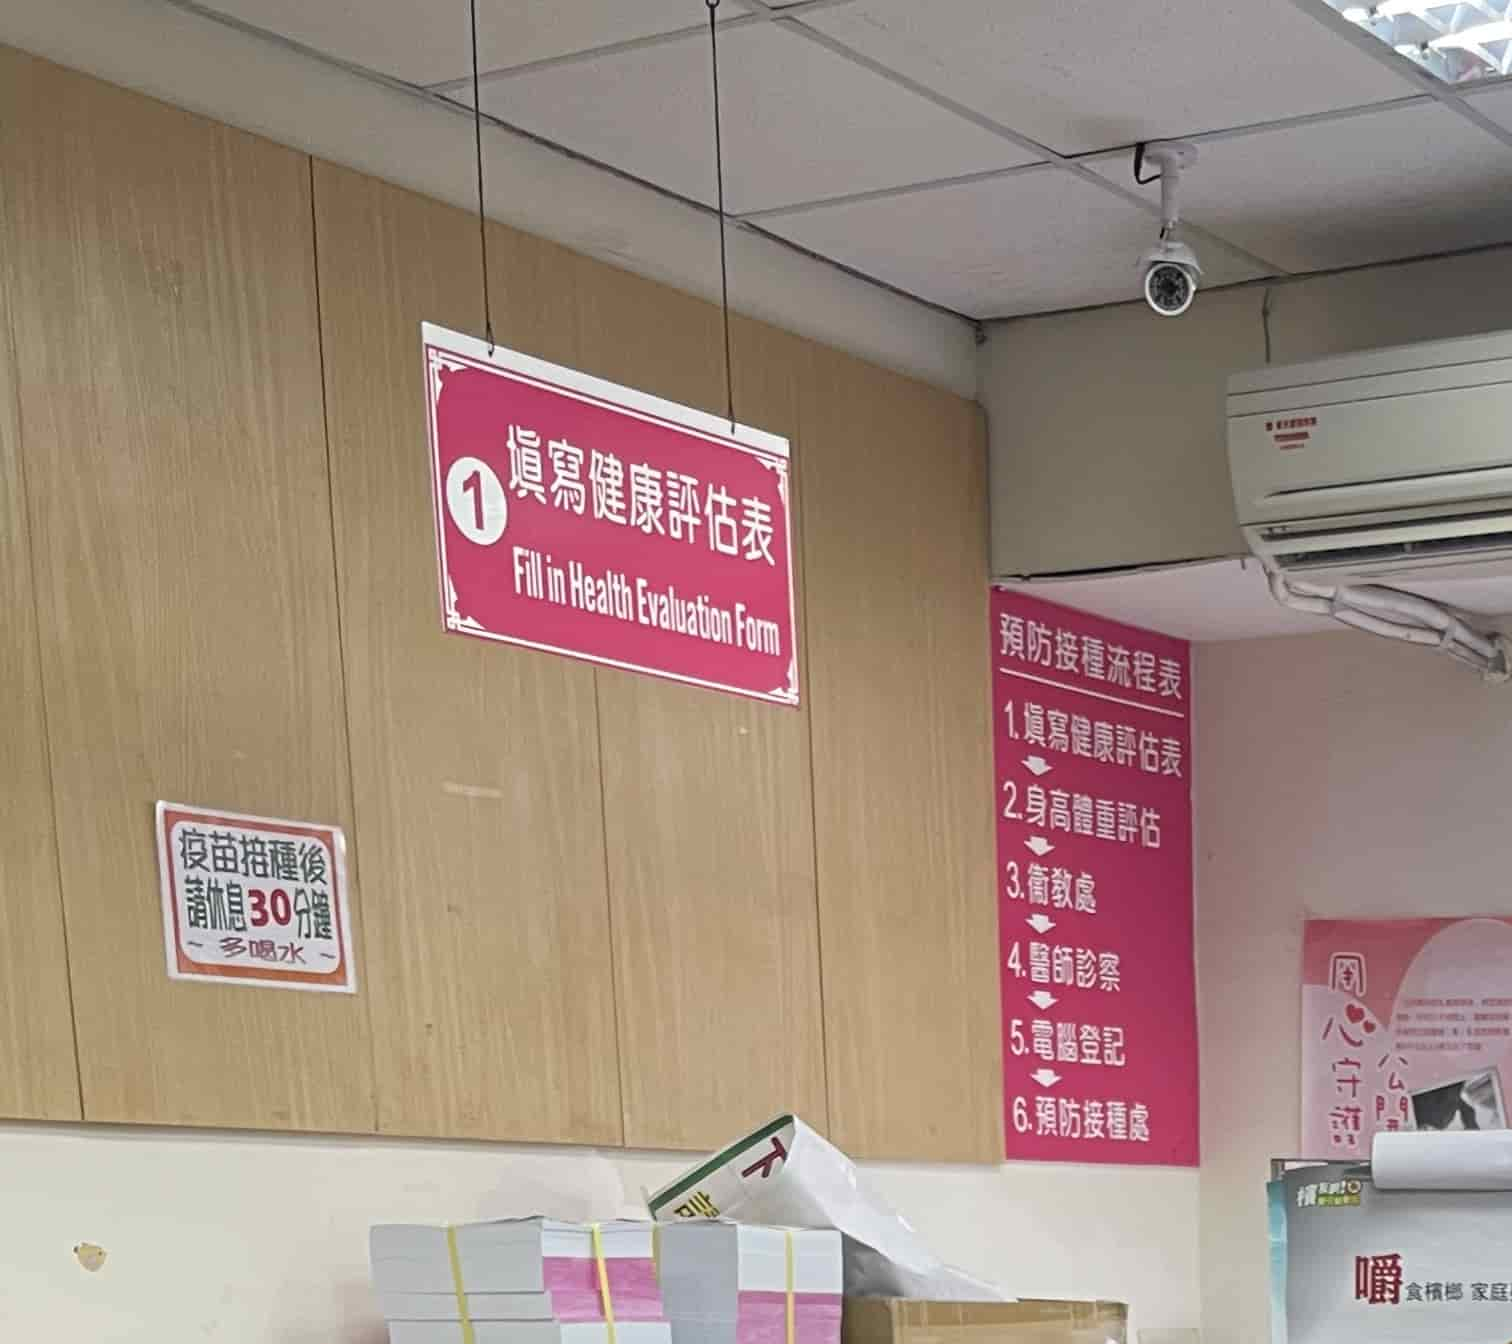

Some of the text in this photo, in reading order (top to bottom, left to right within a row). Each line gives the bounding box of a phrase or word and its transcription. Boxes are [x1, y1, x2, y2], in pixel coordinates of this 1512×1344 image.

[512, 545, 782, 657] Fill in Health Evaluation Form
[1000, 612, 1183, 700] 預防接種流程表
[178, 826, 328, 886] 疫苗接種後
[219, 936, 307, 965] 多喝水
